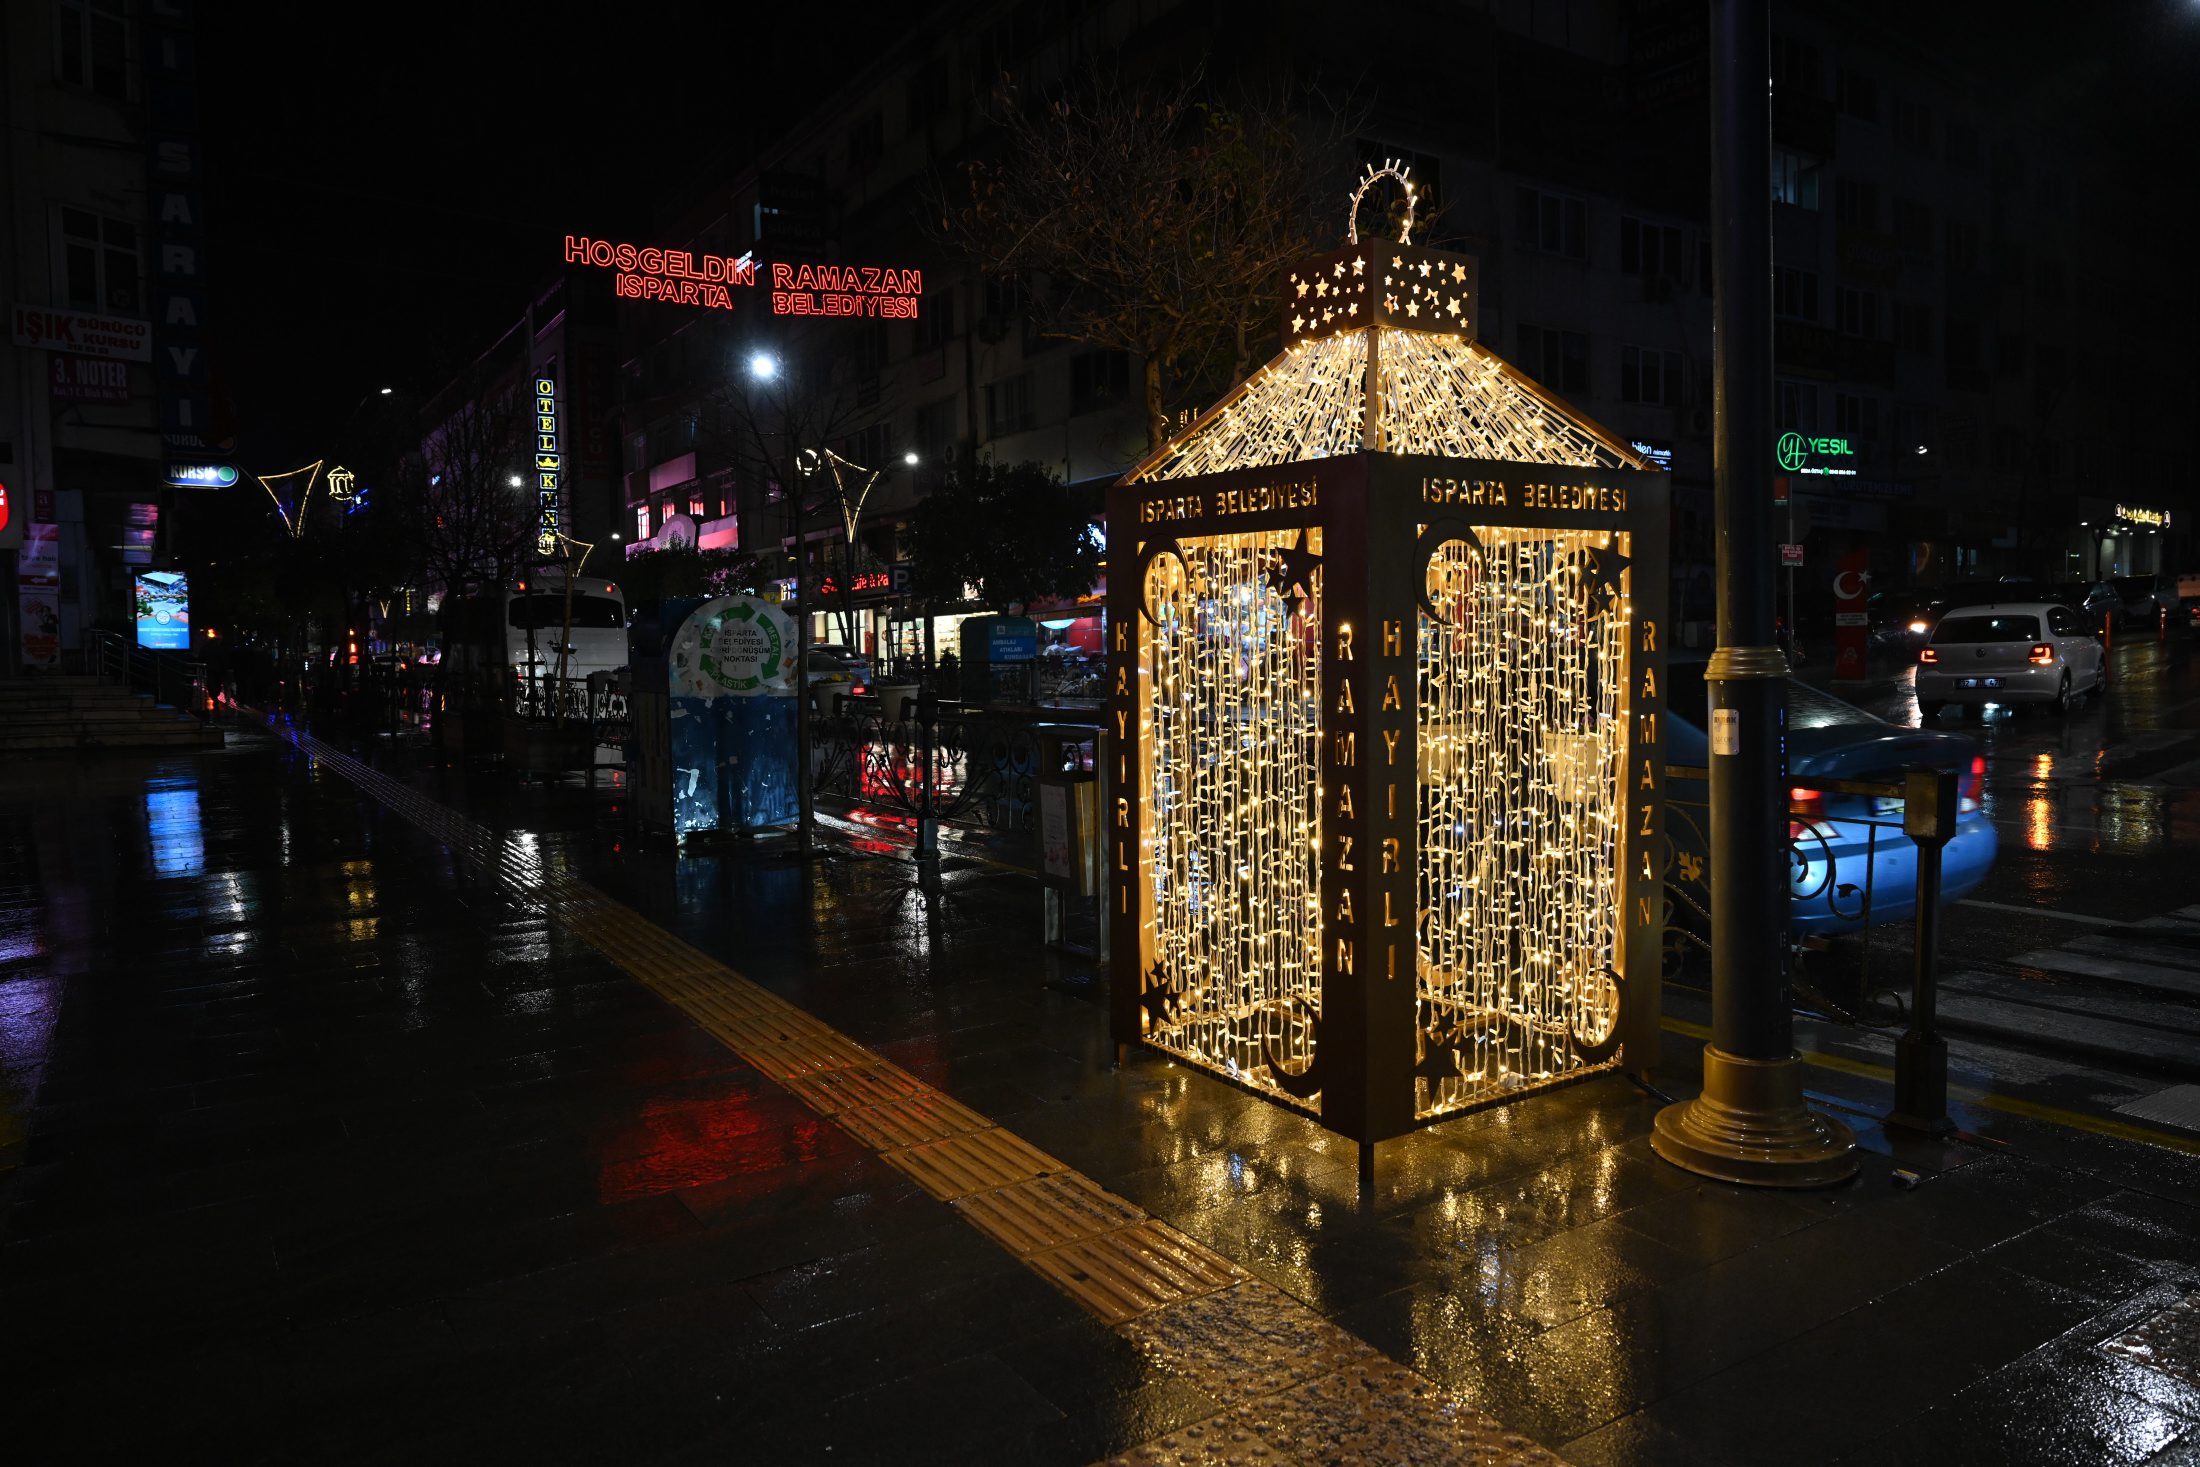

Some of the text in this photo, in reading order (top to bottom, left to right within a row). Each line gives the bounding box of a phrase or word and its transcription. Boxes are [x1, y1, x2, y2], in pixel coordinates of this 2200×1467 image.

[566, 236, 922, 294] HOŞGELDİN RAMAZAN
[616, 273, 918, 319] ISPARTA BELEDİYESİ
[16, 309, 74, 344] IŞIK
[55, 357, 127, 387] 3. NOTER
[539, 381, 553, 449] OTEL
[1808, 437, 1854, 456] YEŞİL
[170, 463, 217, 480] KURSU
[1423, 477, 1508, 507] ISPARTA
[1140, 475, 1317, 523] ISPARTA BELEDİYESİ
[724, 655, 758, 663] NOKTASI
[768, 626, 779, 657] METAL
[1115, 621, 1129, 914] HAYIRLI
[1639, 621, 1657, 927] RAMAZAN
[1336, 623, 1355, 975] RAMAZAN
[1381, 620, 1403, 980] HAYIRLI
